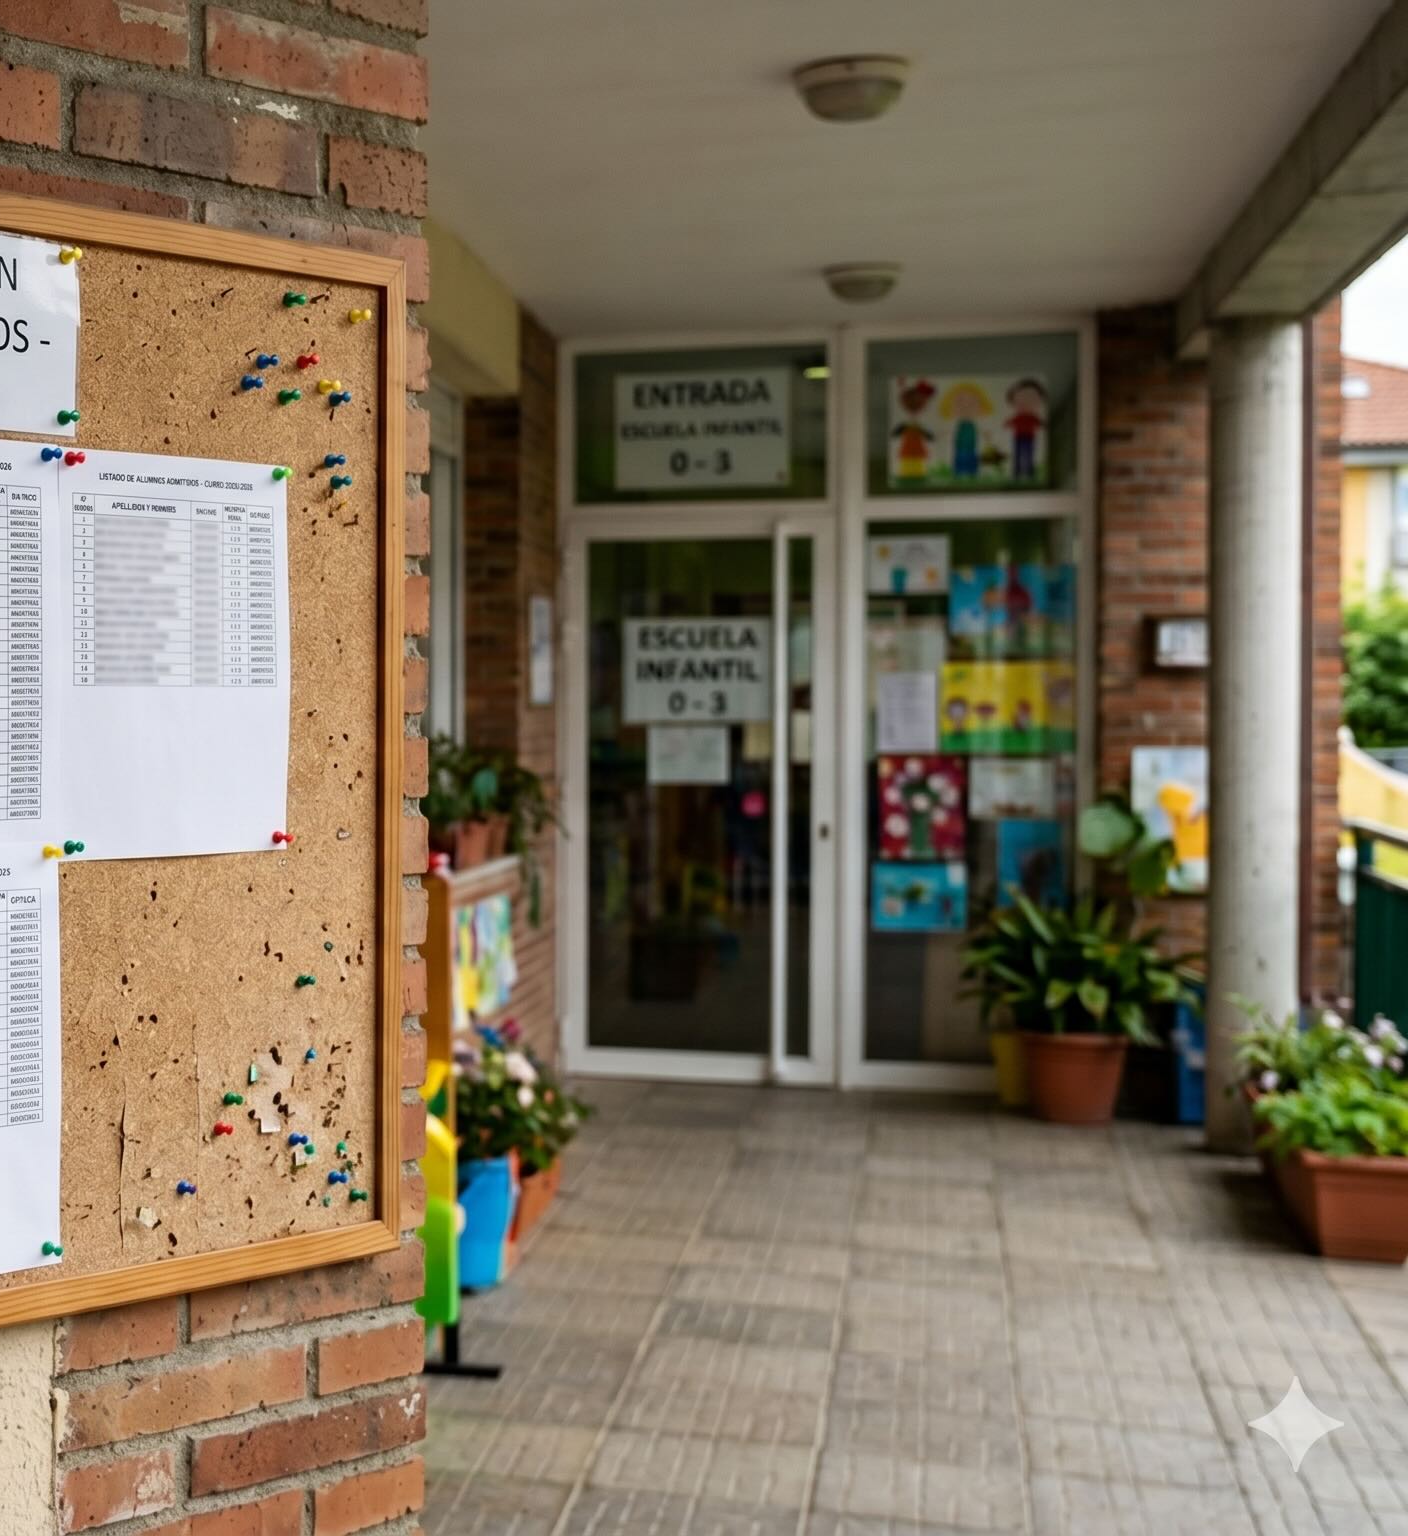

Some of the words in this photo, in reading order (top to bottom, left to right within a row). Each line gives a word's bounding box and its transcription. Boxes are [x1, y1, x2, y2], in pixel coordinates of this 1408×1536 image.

[633, 376, 772, 409] ENTRADA
[621, 422, 697, 440] ESCUELA
[705, 417, 782, 436] INFANTIL
[669, 450, 689, 476] 0
[714, 450, 732, 475] 3
[127, 474, 134, 482] DE
[638, 626, 757, 649] ESCUELA
[636, 658, 760, 682] INFANTIL
[668, 691, 686, 715] 0
[710, 691, 726, 715] 3
